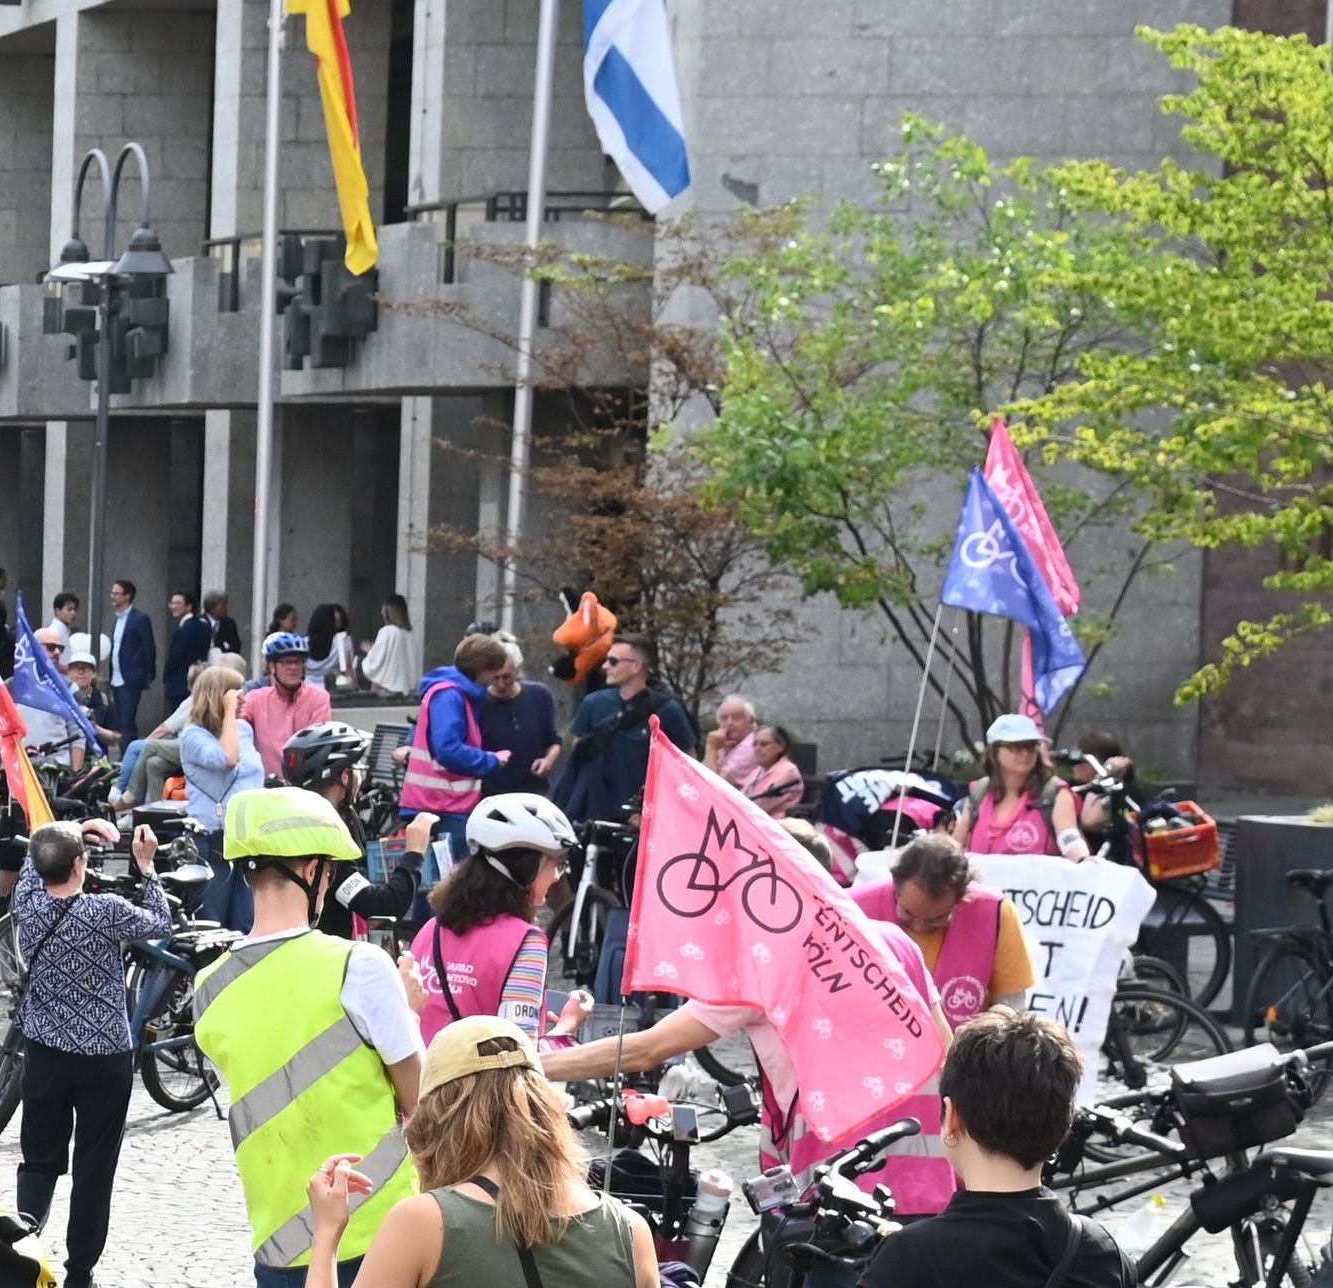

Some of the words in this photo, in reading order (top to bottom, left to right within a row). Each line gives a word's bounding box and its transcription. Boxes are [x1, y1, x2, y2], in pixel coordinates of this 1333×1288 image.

[342, 876, 360, 896] ORDN
[1002, 888, 1116, 929] TSCHEID
[814, 906, 923, 1039] ENTSCHEID
[1039, 941, 1064, 978] T
[514, 1004, 538, 1018] ORDN
[1028, 993, 1089, 1033] EN!
